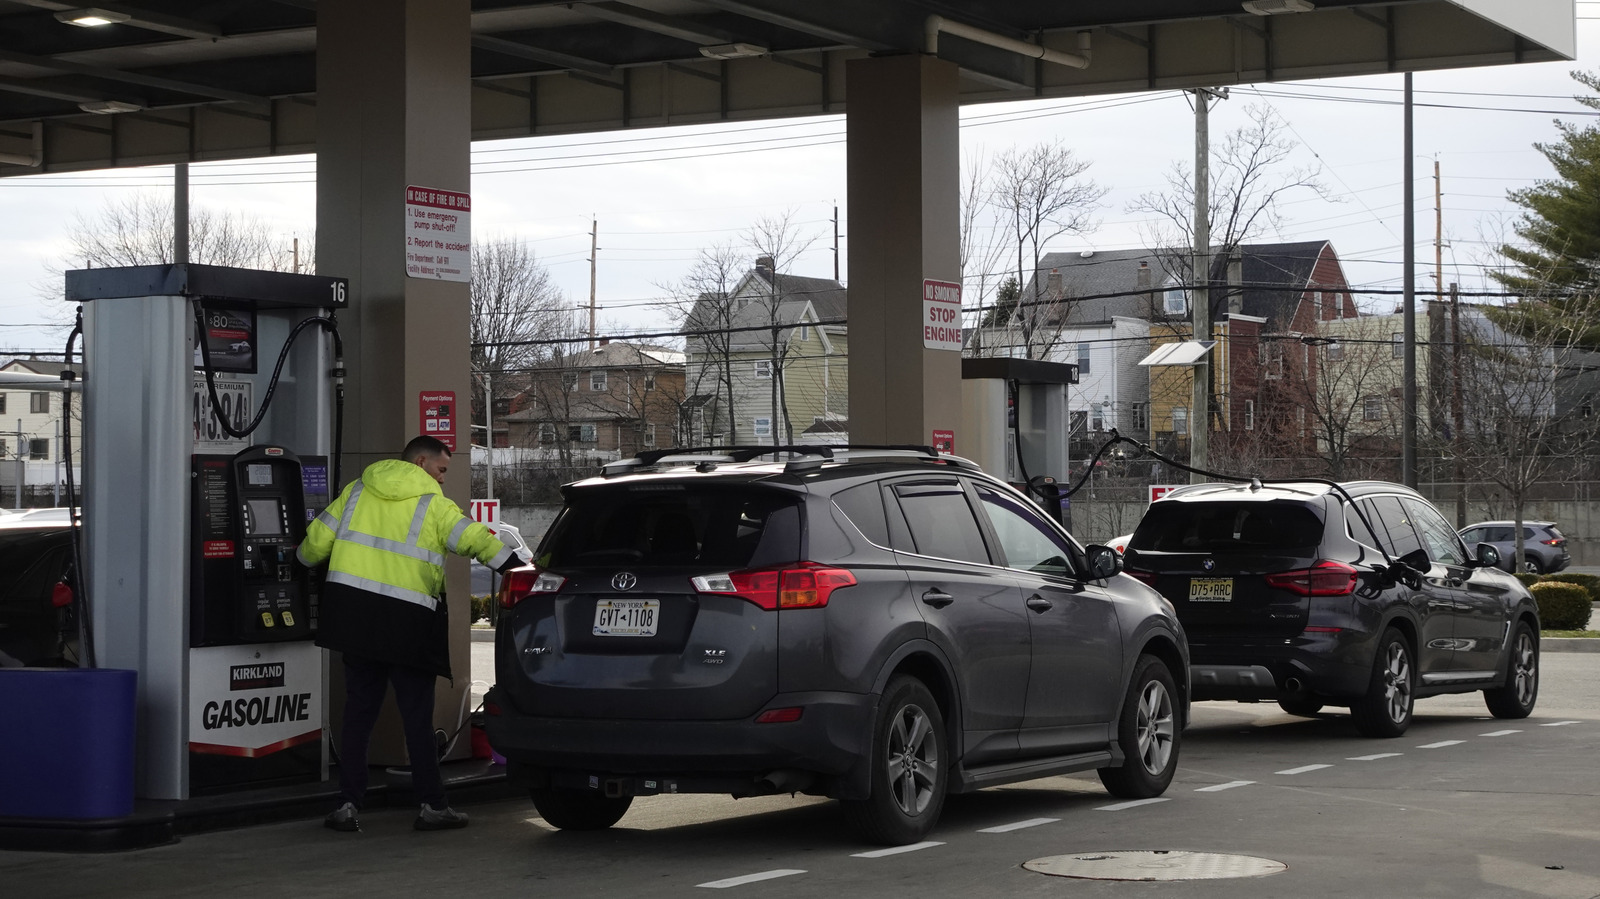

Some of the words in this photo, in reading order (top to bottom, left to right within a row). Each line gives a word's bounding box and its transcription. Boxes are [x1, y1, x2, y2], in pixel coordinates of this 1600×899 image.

[408, 190, 413, 201] IN
[415, 191, 427, 202] CASE
[429, 193, 436, 203] OF
[437, 194, 447, 205] FIRE
[449, 196, 455, 206] OR
[457, 197, 469, 208] SPILL
[408, 208, 412, 217] 1.
[414, 209, 425, 218] Use
[428, 211, 458, 223] emergency
[414, 221, 430, 230] pump
[432, 222, 456, 233] shut-off!
[408, 237, 412, 246] 2.
[415, 238, 433, 248] Report
[435, 240, 443, 249] the
[445, 242, 469, 251] accident!
[330, 282, 345, 302] 16
[926, 284, 933, 299] NO
[934, 286, 959, 302] SMOKING
[209, 315, 228, 328] $80
[930, 307, 955, 323] STOP
[925, 326, 961, 343] ENGINE
[1192, 584, 1208, 595] D75
[1214, 584, 1231, 595] RRC
[600, 609, 620, 626] GVT
[628, 609, 653, 626] 1108
[233, 666, 282, 680] KIRKLAND
[203, 693, 311, 730] GASOLINE
